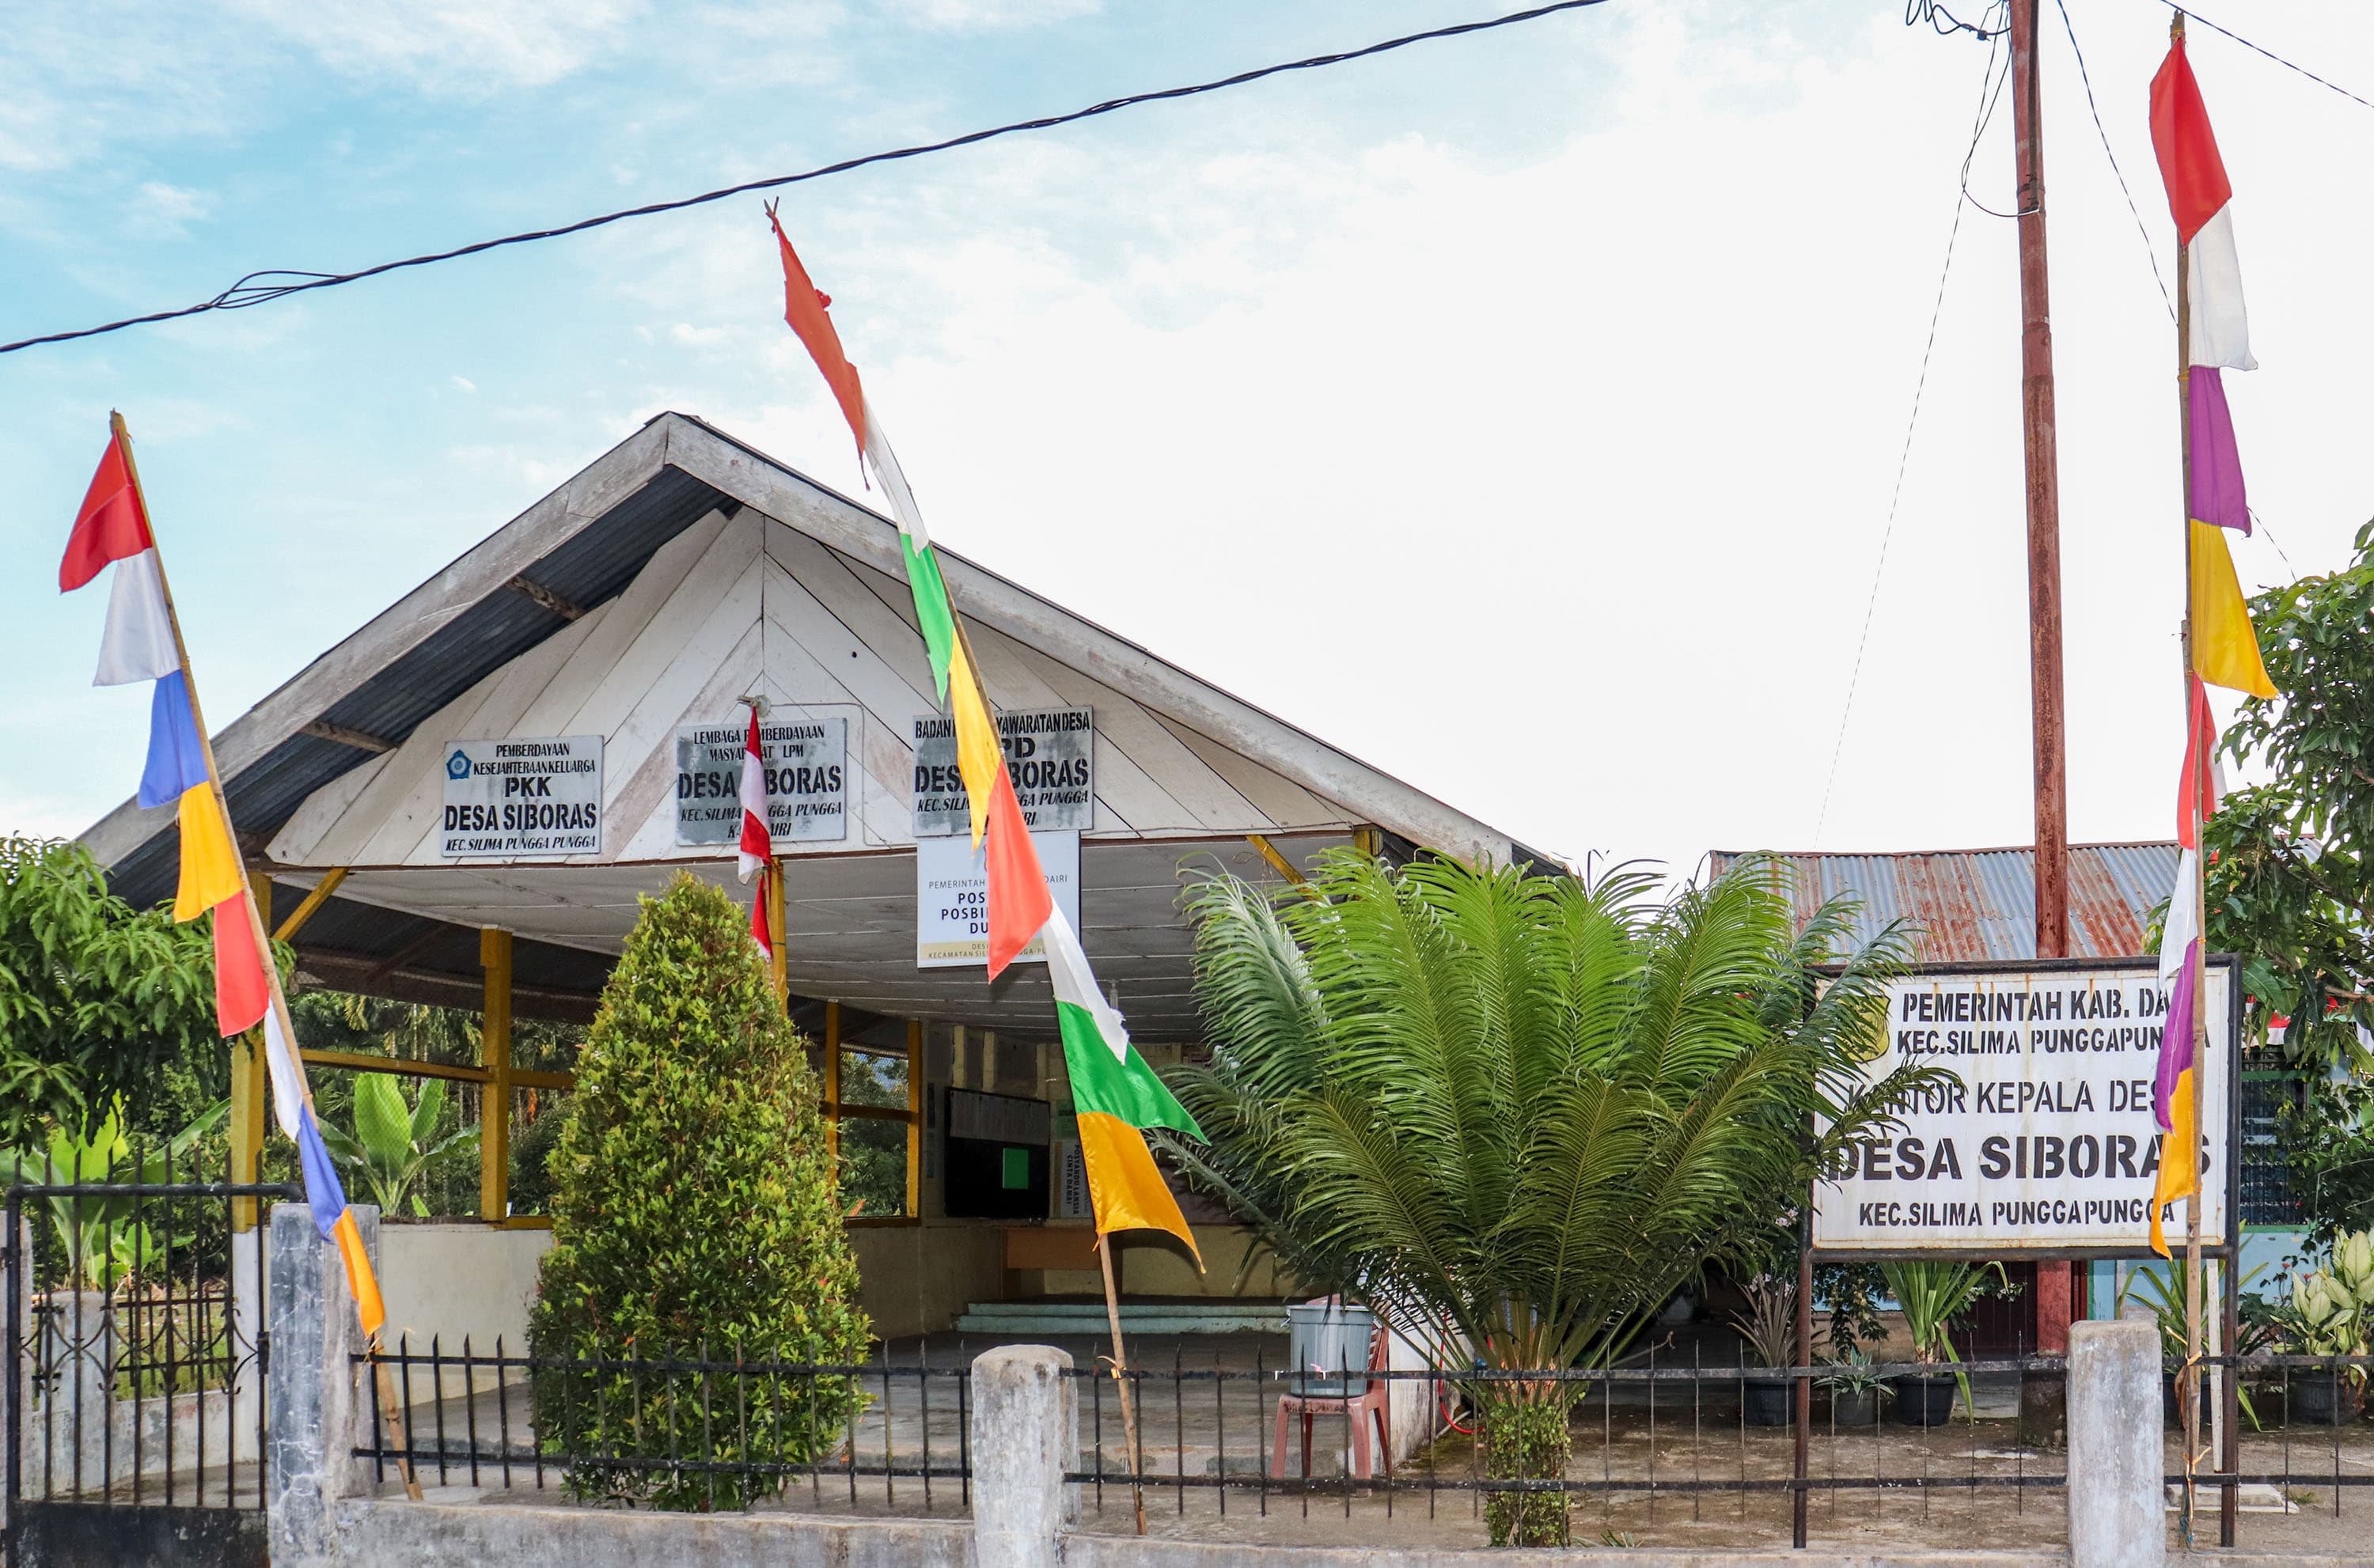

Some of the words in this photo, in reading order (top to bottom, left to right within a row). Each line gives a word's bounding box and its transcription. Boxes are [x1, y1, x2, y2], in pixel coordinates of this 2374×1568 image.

[694, 729, 741, 744] LEMBAGA
[744, 725, 824, 742] PBERDAYAAN
[916, 719, 951, 739] BADAN
[496, 743, 570, 757] PEMBERDAYAAN
[710, 745, 773, 762] MASYAAT
[783, 744, 804, 758] LPM
[1001, 737, 1036, 759] PD
[505, 776, 552, 797] PKK
[678, 771, 738, 799] DESA
[764, 765, 841, 795] BORAS
[915, 764, 966, 793] DES
[1007, 758, 1089, 790] BORAS
[795, 801, 841, 816] PUNGGA
[917, 797, 970, 812] KEC.SILI
[1039, 790, 1088, 805] PUNGGA
[445, 805, 499, 831] DESA
[502, 803, 597, 830] SIBORAS
[505, 837, 548, 850] PUNGGA
[552, 835, 595, 848] PUNGGA
[928, 879, 985, 890] PEMERINTAH
[1902, 991, 2062, 1023] PEMERINTAH
[2070, 989, 2130, 1020] KAB.
[2031, 1025, 2211, 1055] PUNGGAPUN
[1845, 1082, 1967, 1115] KNTOR
[1977, 1080, 2095, 1115] KEPALA
[2109, 1079, 2156, 1112] DE
[1827, 1137, 1963, 1181] DESA
